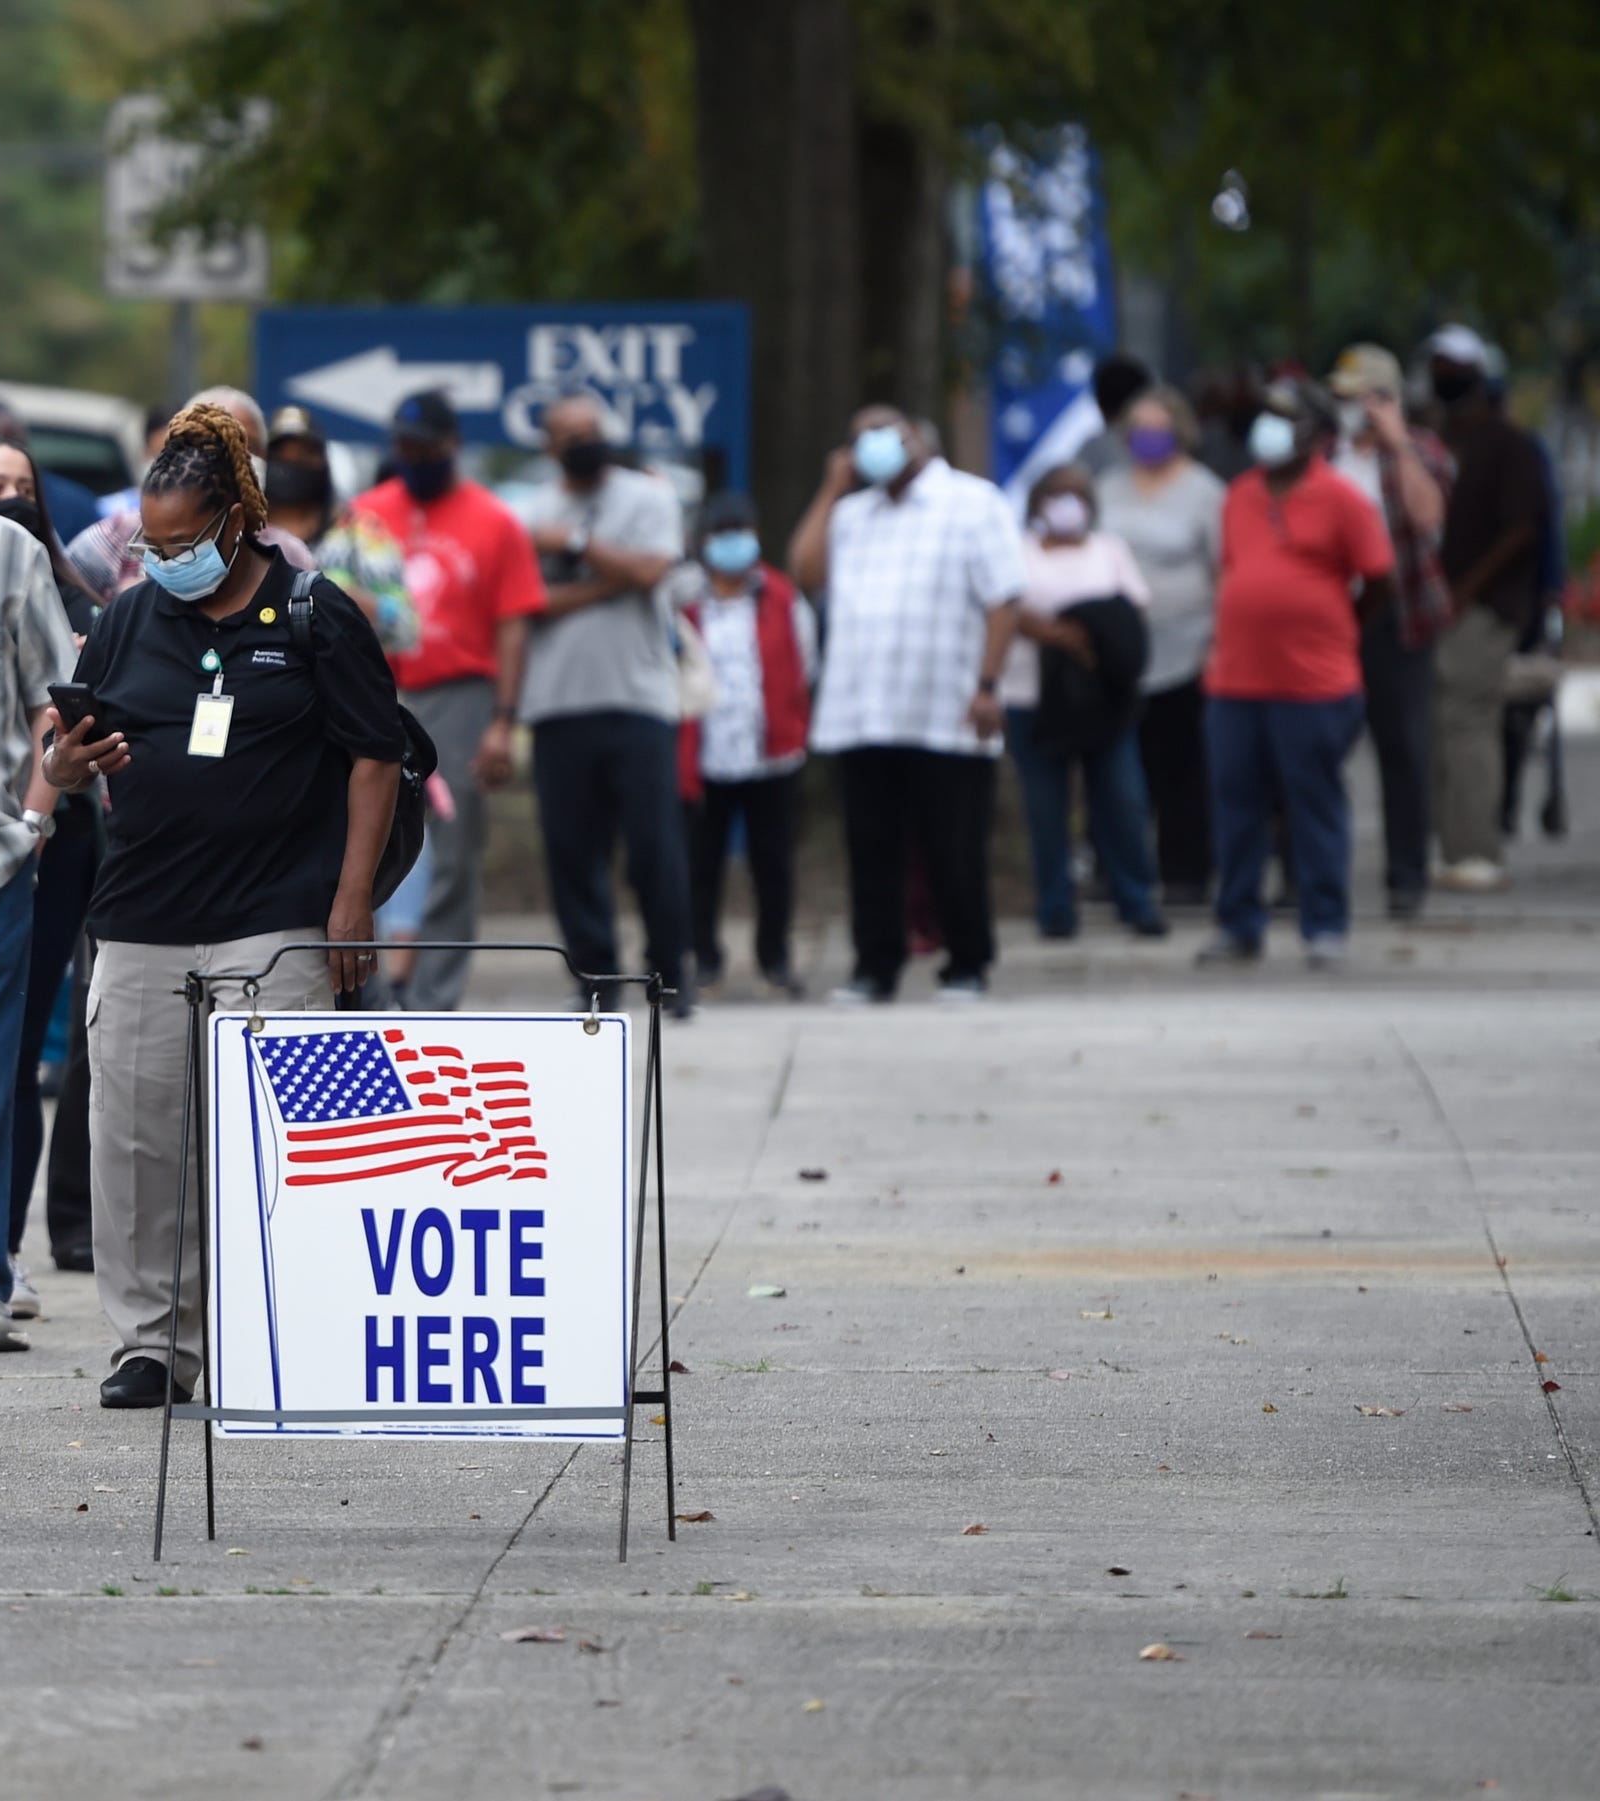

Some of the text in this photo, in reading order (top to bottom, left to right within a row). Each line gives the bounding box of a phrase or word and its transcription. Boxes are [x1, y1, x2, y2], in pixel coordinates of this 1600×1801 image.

[528, 323, 695, 383] EXIT
[361, 1207, 546, 1297] VOTE
[365, 1315, 547, 1405] HERE
